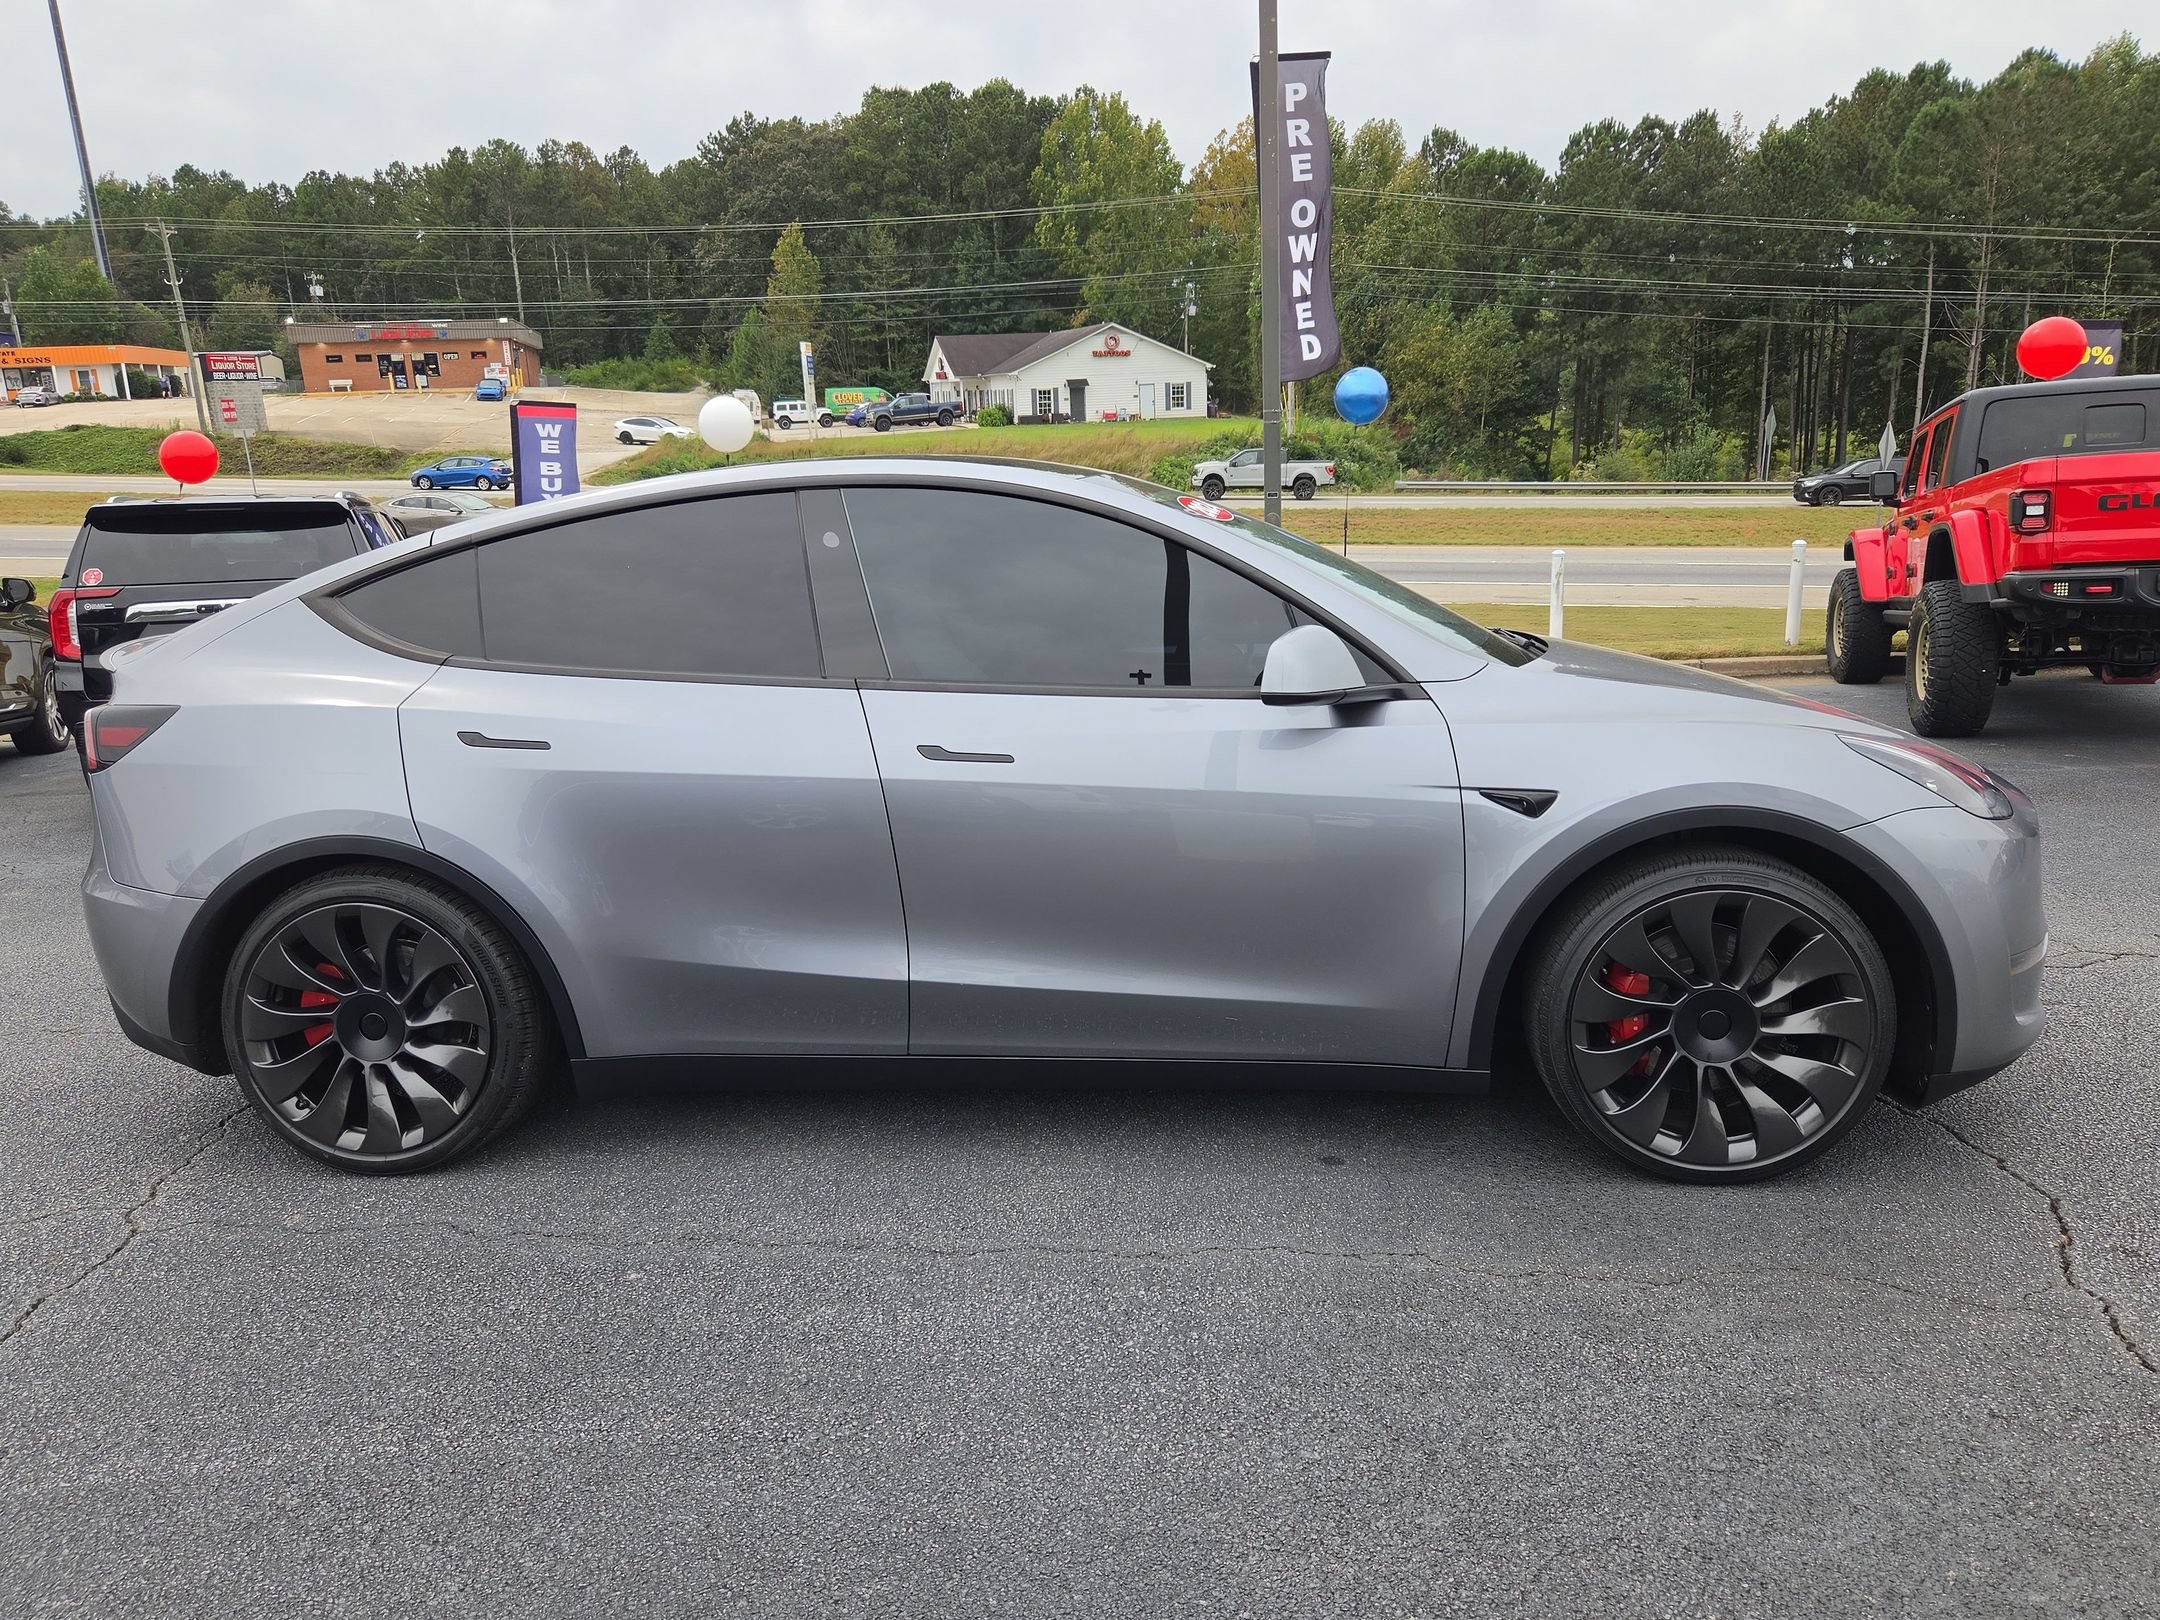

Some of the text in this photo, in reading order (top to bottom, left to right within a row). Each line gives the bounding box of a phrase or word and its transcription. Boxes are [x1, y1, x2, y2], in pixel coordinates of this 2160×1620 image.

[1284, 82, 1322, 361] PRE OWNED
[14, 356, 52, 364] SIGNS
[236, 360, 257, 370] STORE
[833, 392, 864, 402] CLOVER
[534, 423, 563, 454] WE
[2098, 491, 2160, 512] GL
